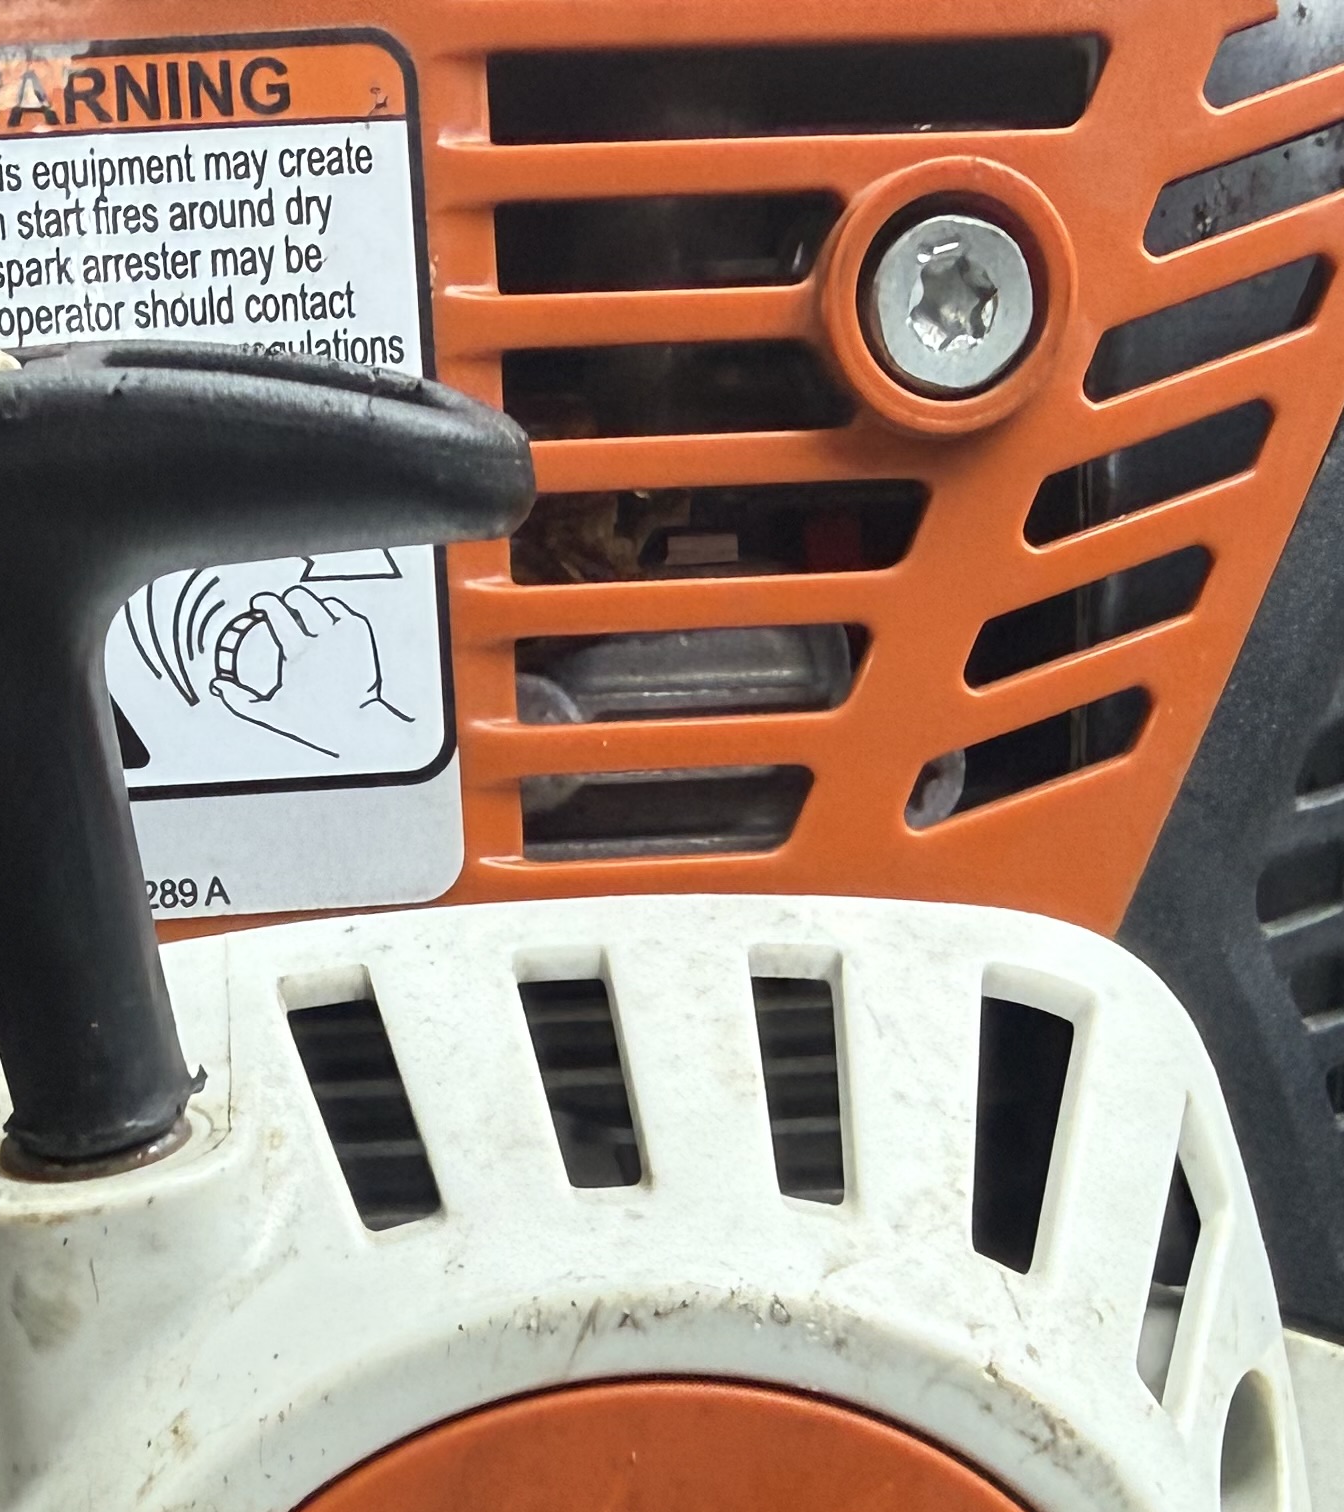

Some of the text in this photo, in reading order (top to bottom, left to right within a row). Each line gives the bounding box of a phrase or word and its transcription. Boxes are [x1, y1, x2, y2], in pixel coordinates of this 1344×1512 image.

[32, 144, 196, 200] equipment
[205, 149, 268, 190] may
[278, 137, 373, 177] create
[17, 198, 88, 240] start
[92, 196, 159, 235] fires
[169, 187, 275, 231] around
[285, 185, 332, 235] dry
[82, 242, 202, 284] arrester
[211, 244, 275, 285] may
[285, 235, 324, 273] be
[134, 284, 235, 329] should
[244, 281, 357, 323] contact
[205, 876, 231, 906] A
